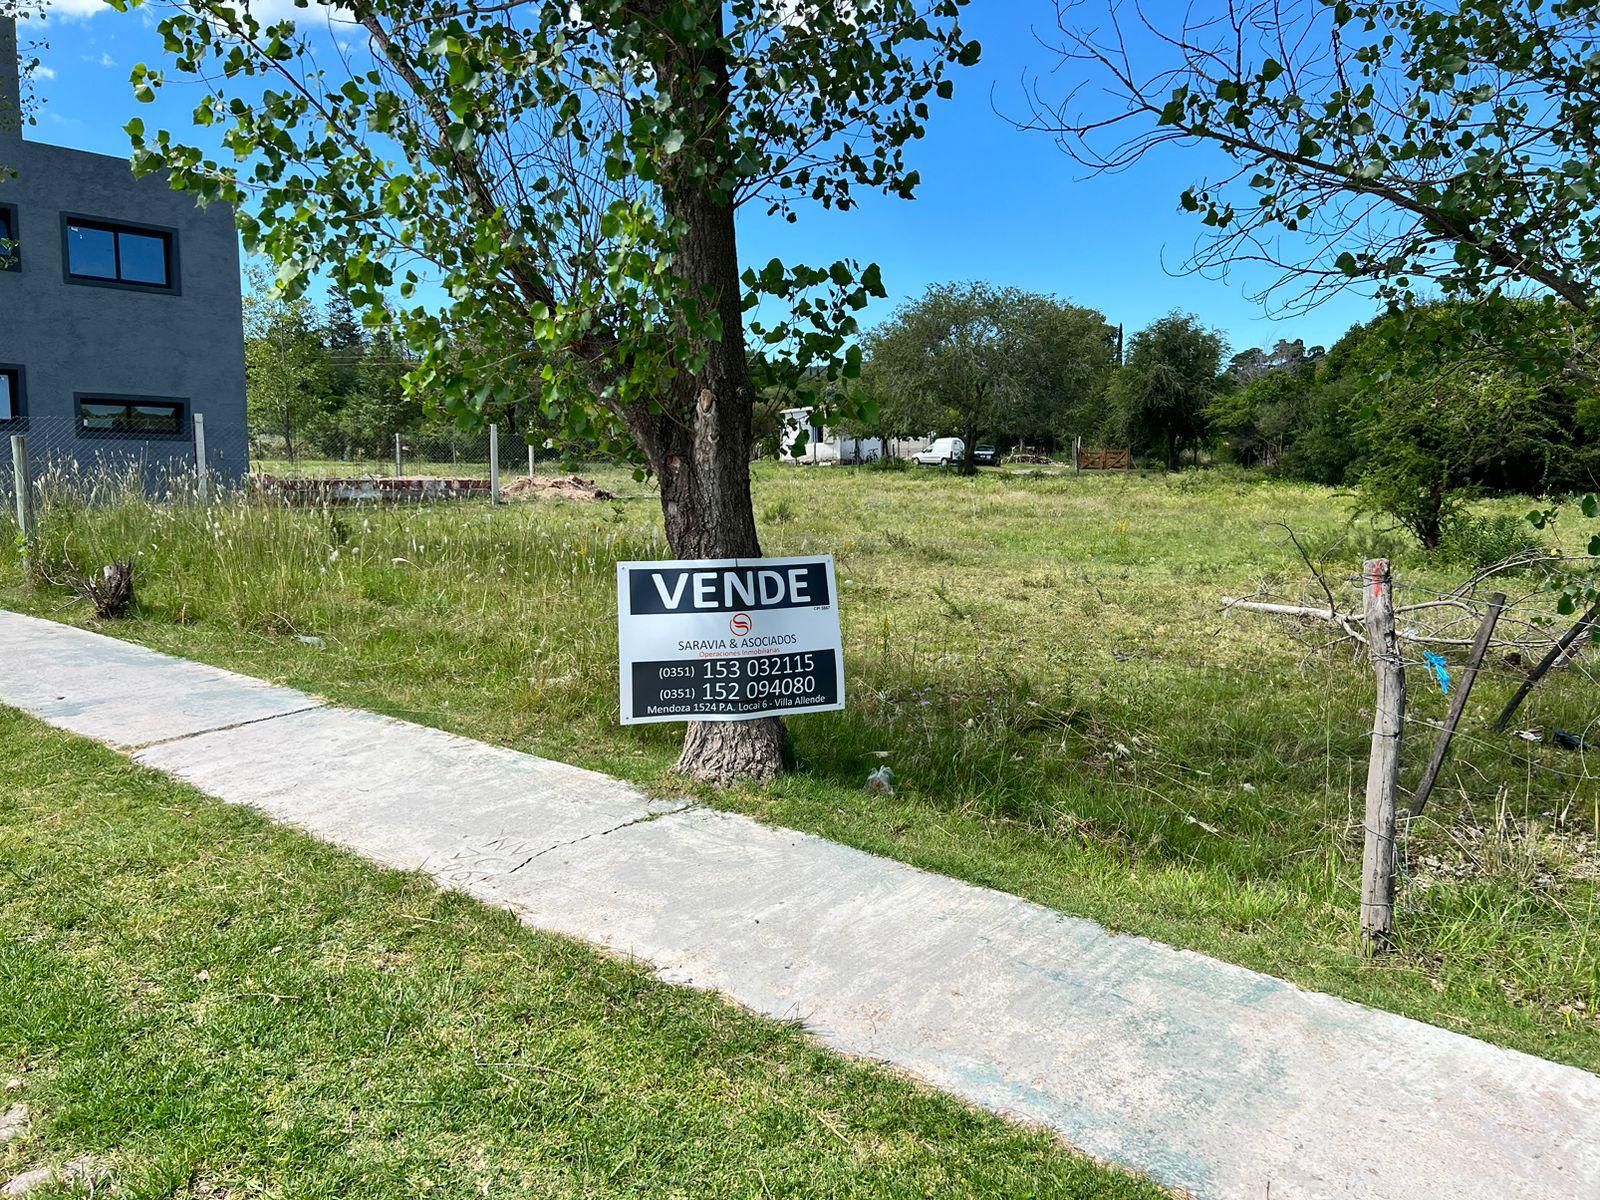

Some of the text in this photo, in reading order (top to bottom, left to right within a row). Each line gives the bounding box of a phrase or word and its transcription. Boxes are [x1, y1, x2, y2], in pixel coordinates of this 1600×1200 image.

[651, 568, 811, 610] VENDE
[678, 634, 797, 651] SARAVIA & ASOCIADOS
[699, 647, 780, 658] Operaciones Inmobiliarias
[659, 654, 815, 680] (0351) 153 032115
[659, 675, 815, 701] (0351) 152 094080
[647, 704, 691, 714] Mendoza
[693, 702, 717, 712] 1524
[719, 702, 736, 712] P.A.
[738, 700, 761, 712] Local
[774, 697, 793, 707] Villa
[794, 694, 826, 705] Allende
